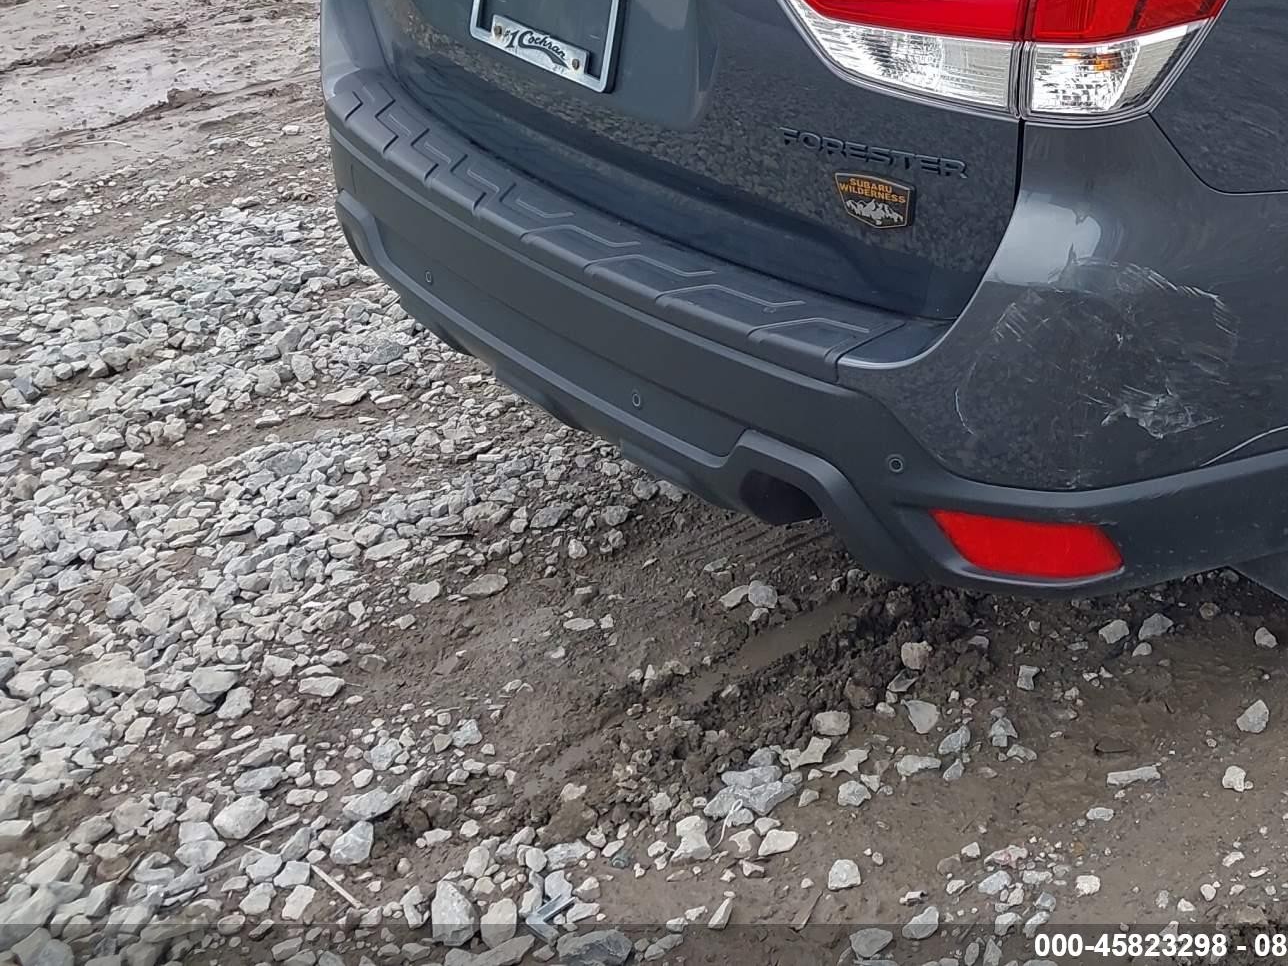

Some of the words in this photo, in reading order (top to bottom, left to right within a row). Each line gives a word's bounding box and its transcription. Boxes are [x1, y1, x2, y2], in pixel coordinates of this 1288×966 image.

[518, 30, 568, 61] Cochran
[778, 127, 968, 179] FORESTER
[839, 183, 906, 203] WILDERNESS
[849, 178, 893, 194] SUBARU
